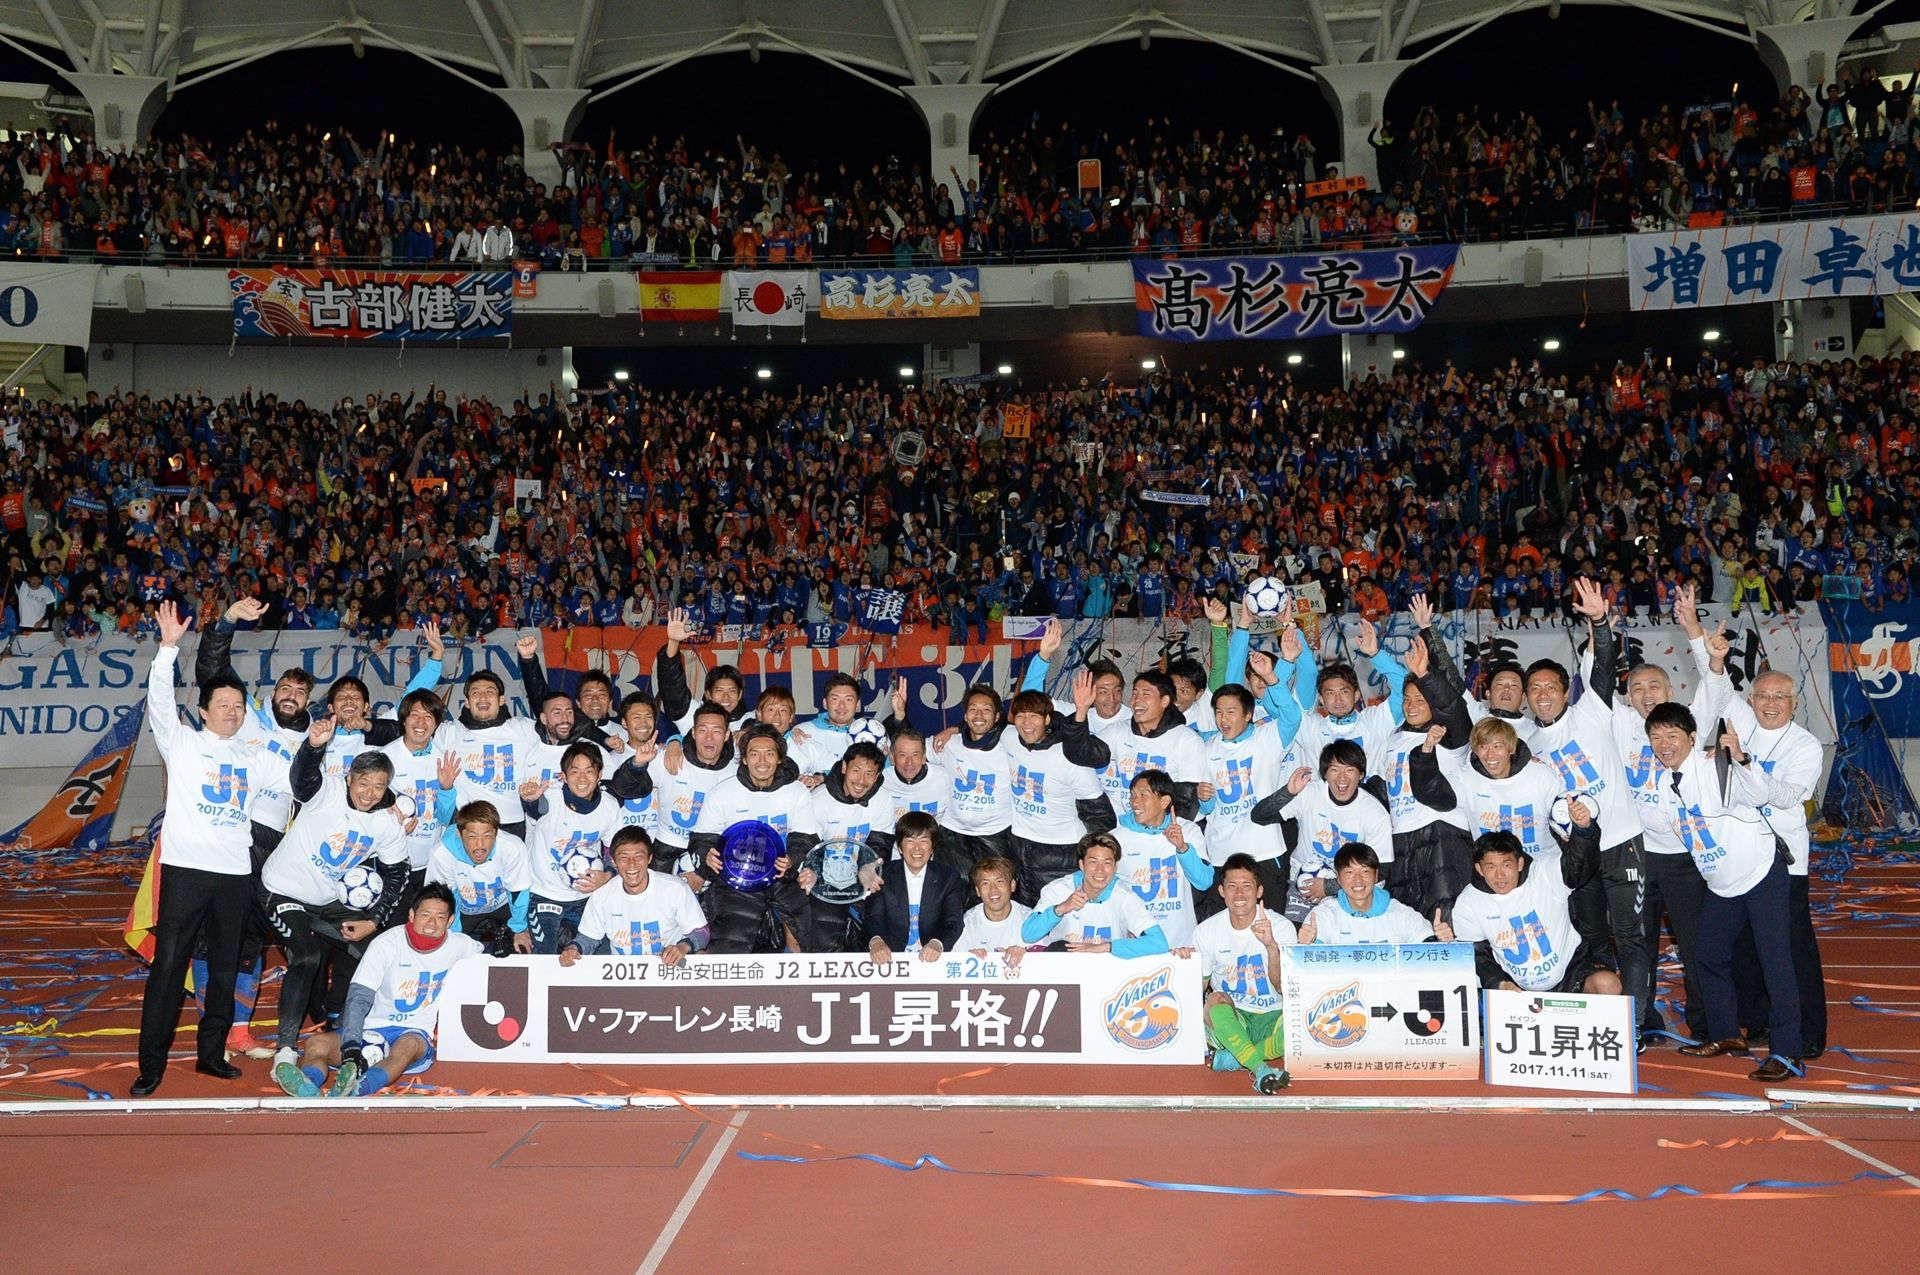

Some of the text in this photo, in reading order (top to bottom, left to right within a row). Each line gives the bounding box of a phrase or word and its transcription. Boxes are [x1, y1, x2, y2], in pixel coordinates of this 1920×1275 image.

[520, 268, 530, 283] 6
[305, 280, 506, 331] 古部健太
[1006, 424, 1025, 437] J1
[815, 625, 831, 640] 19
[465, 744, 513, 785] J1
[201, 764, 248, 810] J1
[494, 782, 516, 791] 2018
[955, 769, 995, 795] J1
[1011, 765, 1045, 803] J1
[1217, 756, 1253, 804] J1
[196, 803, 224, 816] 2017
[973, 796, 995, 805] 2018
[1024, 802, 1046, 815] 2018
[624, 814, 645, 824] 2017
[320, 830, 374, 870] J1
[1700, 846, 1726, 863] 2018
[1132, 855, 1178, 902] J1
[1626, 869, 1638, 882] TM
[1159, 901, 1182, 912] 2018
[1504, 909, 1553, 965] J1
[602, 963, 647, 980] 2017
[658, 962, 764, 980] 明治安田生命
[776, 963, 800, 980] J2
[946, 957, 999, 979] 第2位
[1221, 953, 1270, 996] J1
[1534, 953, 1560, 976] 2018
[1249, 995, 1275, 1007] 2018
[797, 987, 1059, 1049] J1昇格!!
[1496, 1022, 1624, 1062] J1昇格
